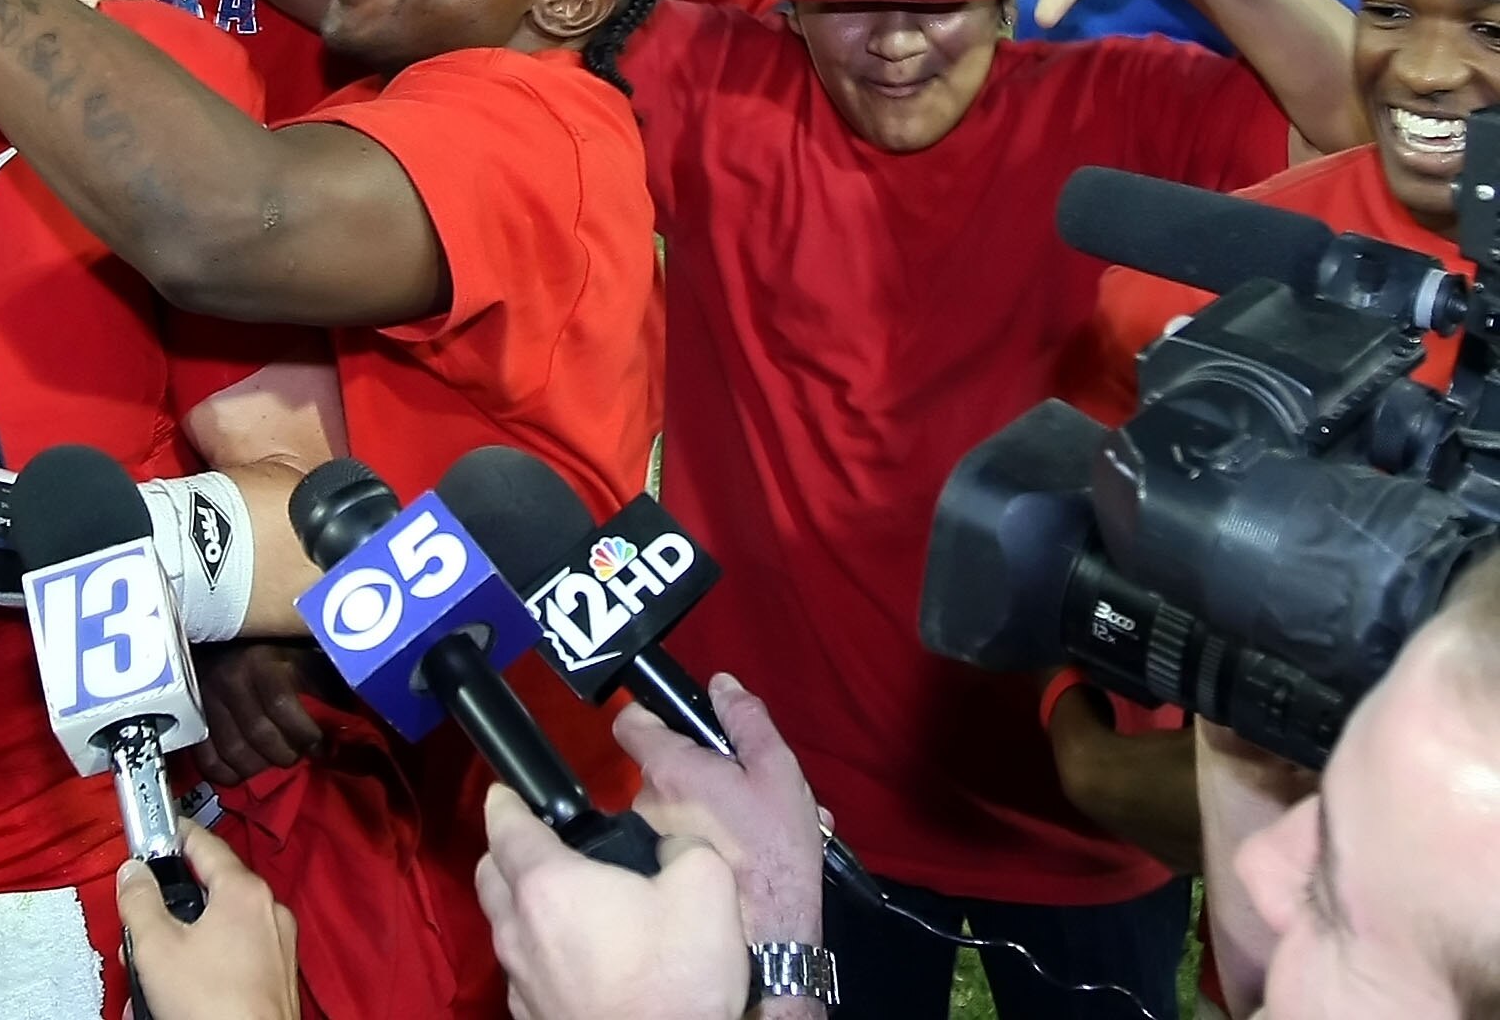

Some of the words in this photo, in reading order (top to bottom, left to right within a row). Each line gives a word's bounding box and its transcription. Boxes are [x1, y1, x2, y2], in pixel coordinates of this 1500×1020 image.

[196, 505, 222, 563] PRO
[388, 510, 468, 599] 5
[40, 553, 168, 716] 13
